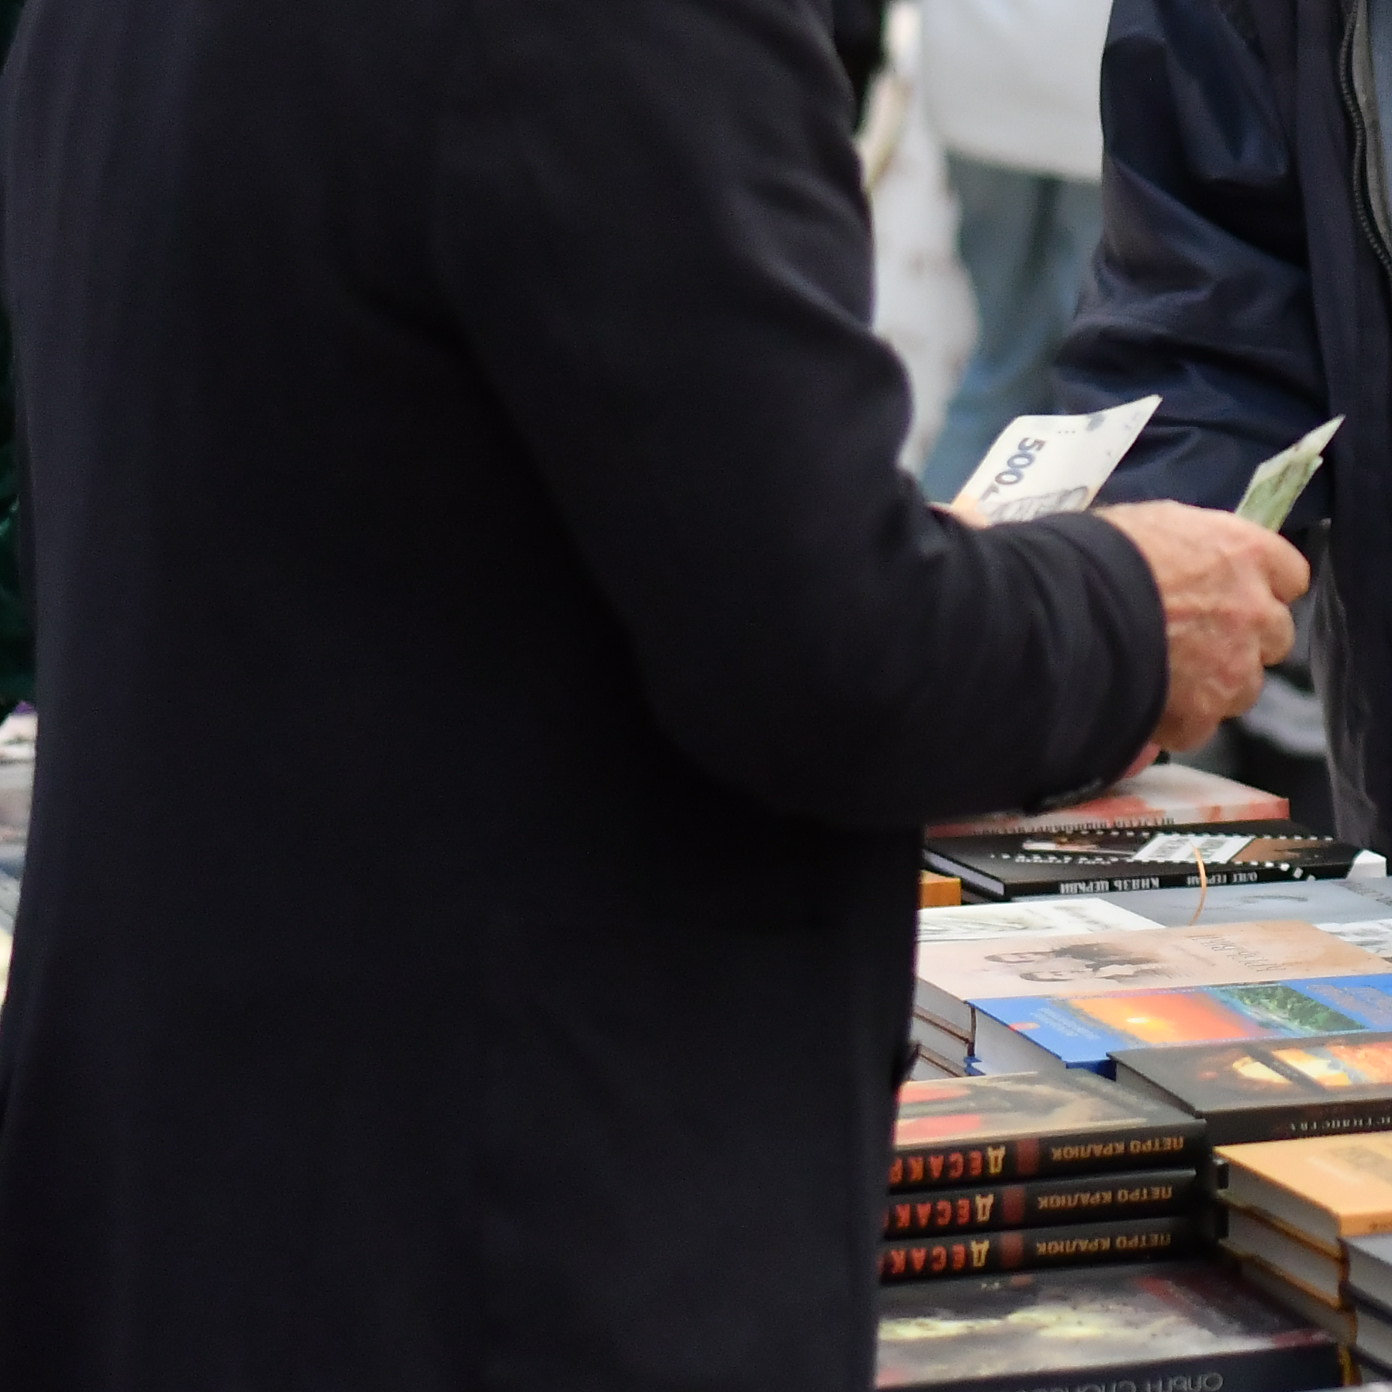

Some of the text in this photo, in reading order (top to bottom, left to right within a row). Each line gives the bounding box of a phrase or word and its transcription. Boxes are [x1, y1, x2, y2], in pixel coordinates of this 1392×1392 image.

[994, 436, 1047, 487] 500
[1113, 876, 1161, 892] КНЯЗЬ
[1050, 1140, 1125, 1161] КРАЛЮК
[1129, 1135, 1185, 1155] ПЕТРО
[884, 1184, 1174, 1230] ПЕТРО КРАЛЮК ДЕСАК
[881, 1231, 1172, 1275] ПЕТРО КРАЛЮК ДЕСАК
